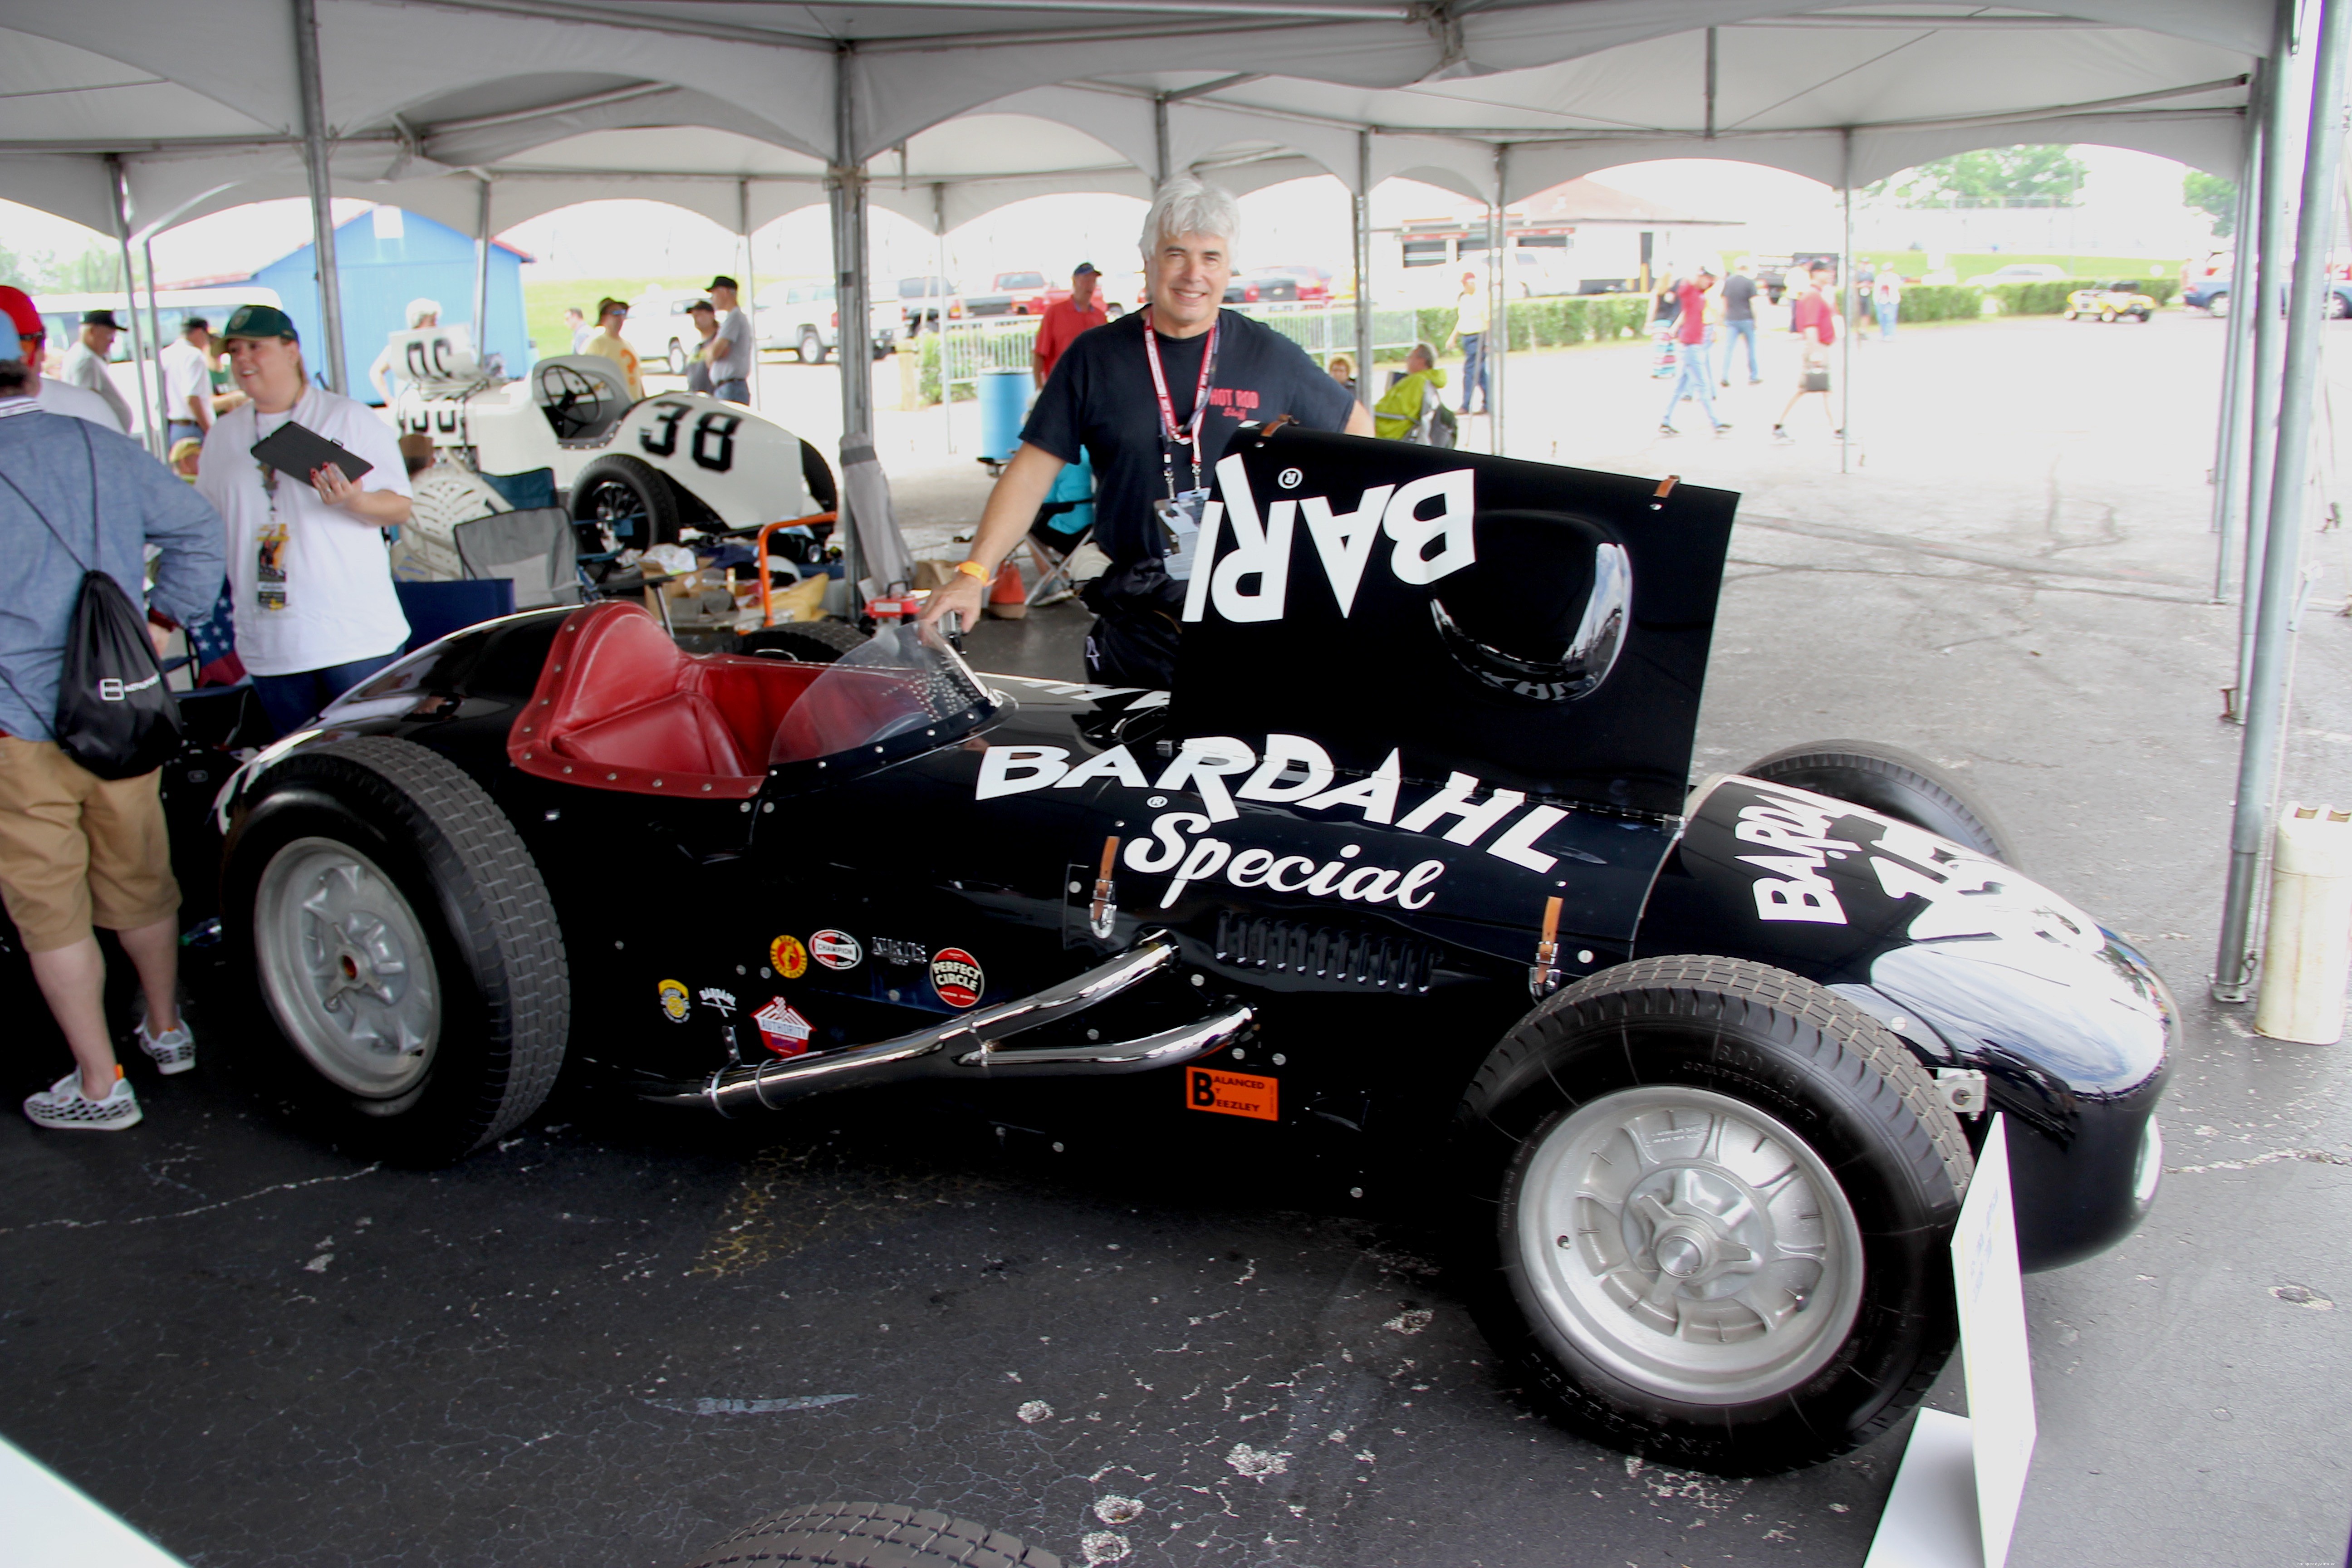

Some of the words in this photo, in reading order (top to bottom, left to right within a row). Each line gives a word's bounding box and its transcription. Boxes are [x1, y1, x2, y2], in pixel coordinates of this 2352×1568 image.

[640, 401, 744, 473] 38
[976, 734, 1570, 874] BARDAHL
[1123, 812, 1446, 910] Special
[817, 943, 852, 954] CHAMPION
[932, 961, 981, 980] PERFECT
[936, 973, 978, 991] CIRCLE
